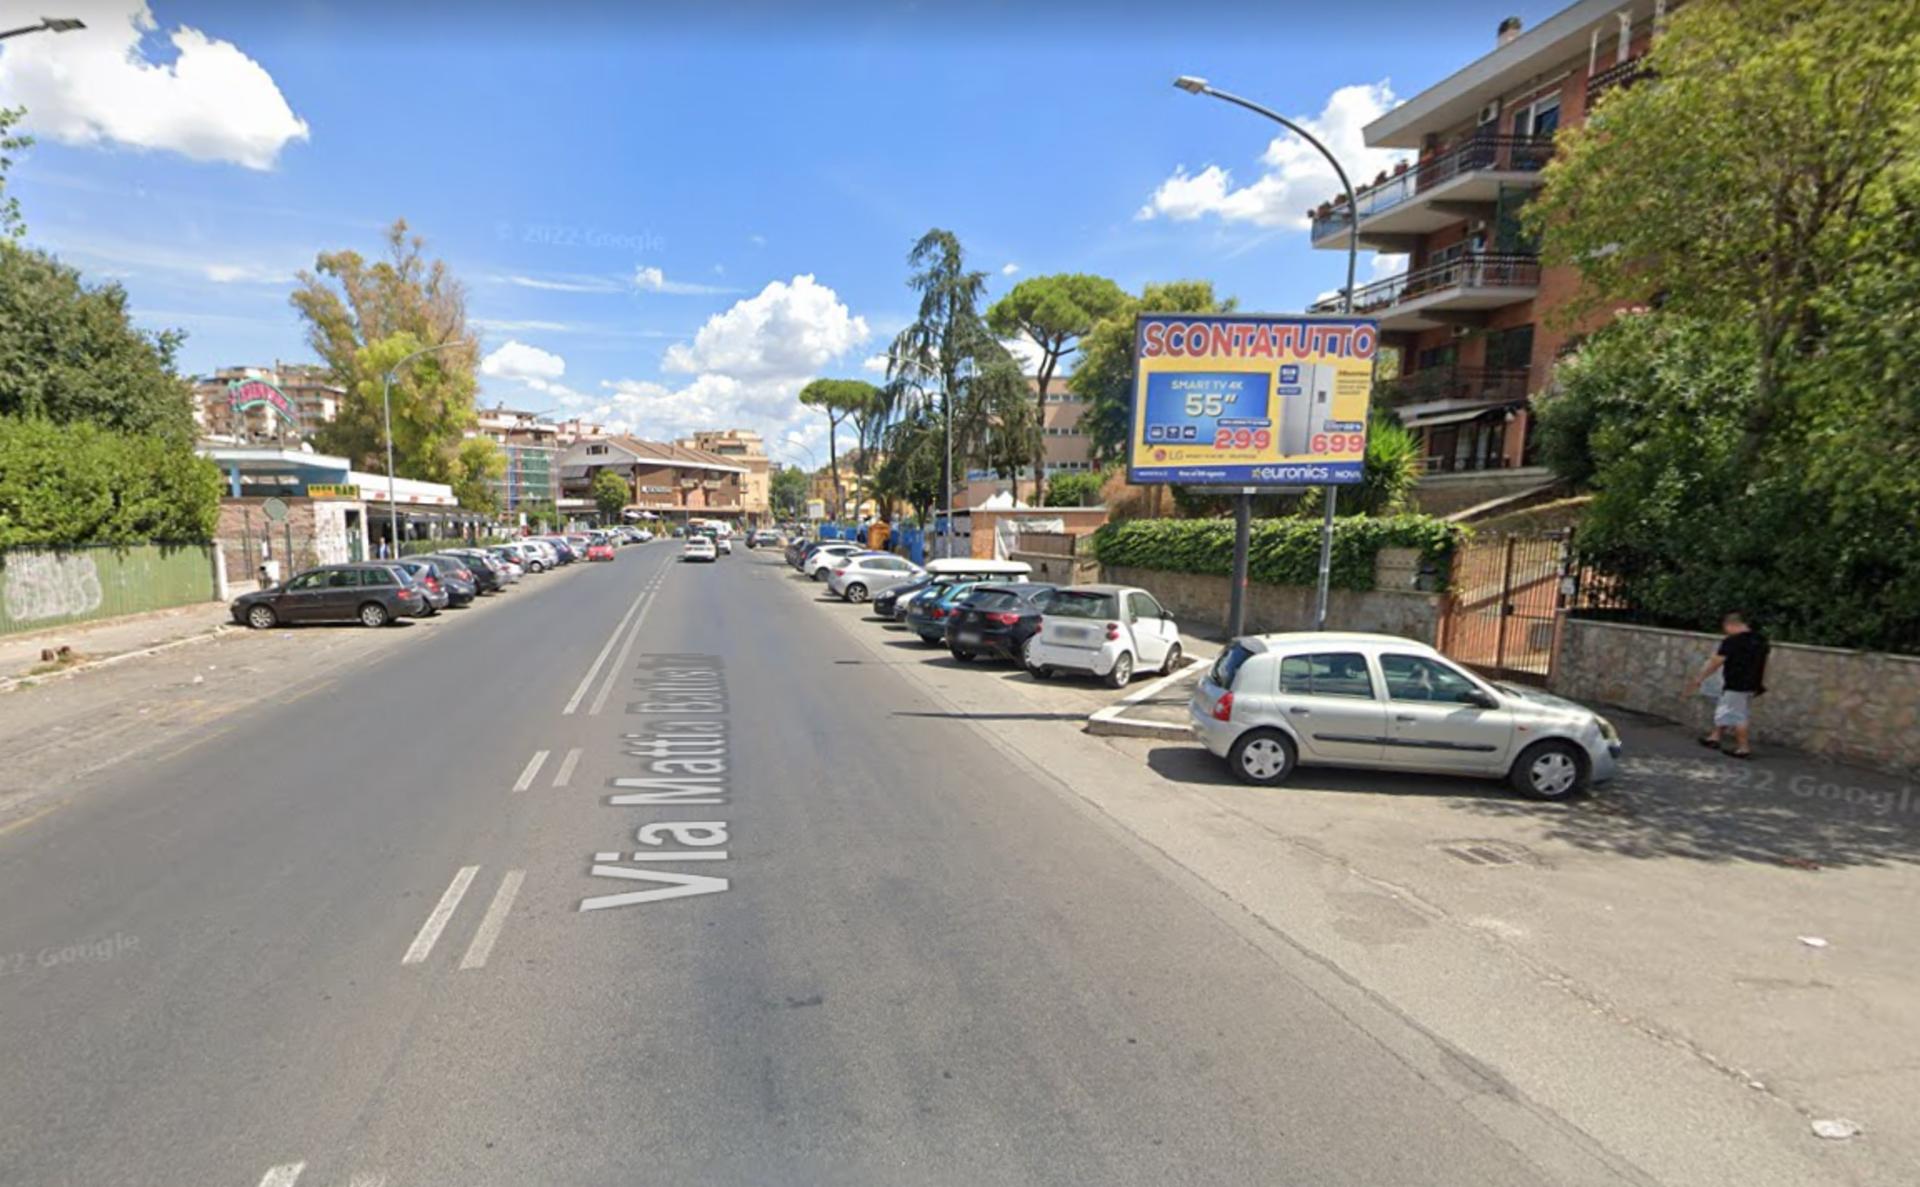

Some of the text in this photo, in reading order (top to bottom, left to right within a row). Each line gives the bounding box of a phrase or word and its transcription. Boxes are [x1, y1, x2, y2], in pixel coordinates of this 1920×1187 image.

[1144, 321, 1376, 359] SCONTATUTTO
[1171, 379, 1243, 391] SMART TV 4K
[1214, 428, 1271, 450] 299
[1311, 433, 1364, 454] 699
[1168, 450, 1184, 460] LG
[1261, 464, 1328, 479] euronics
